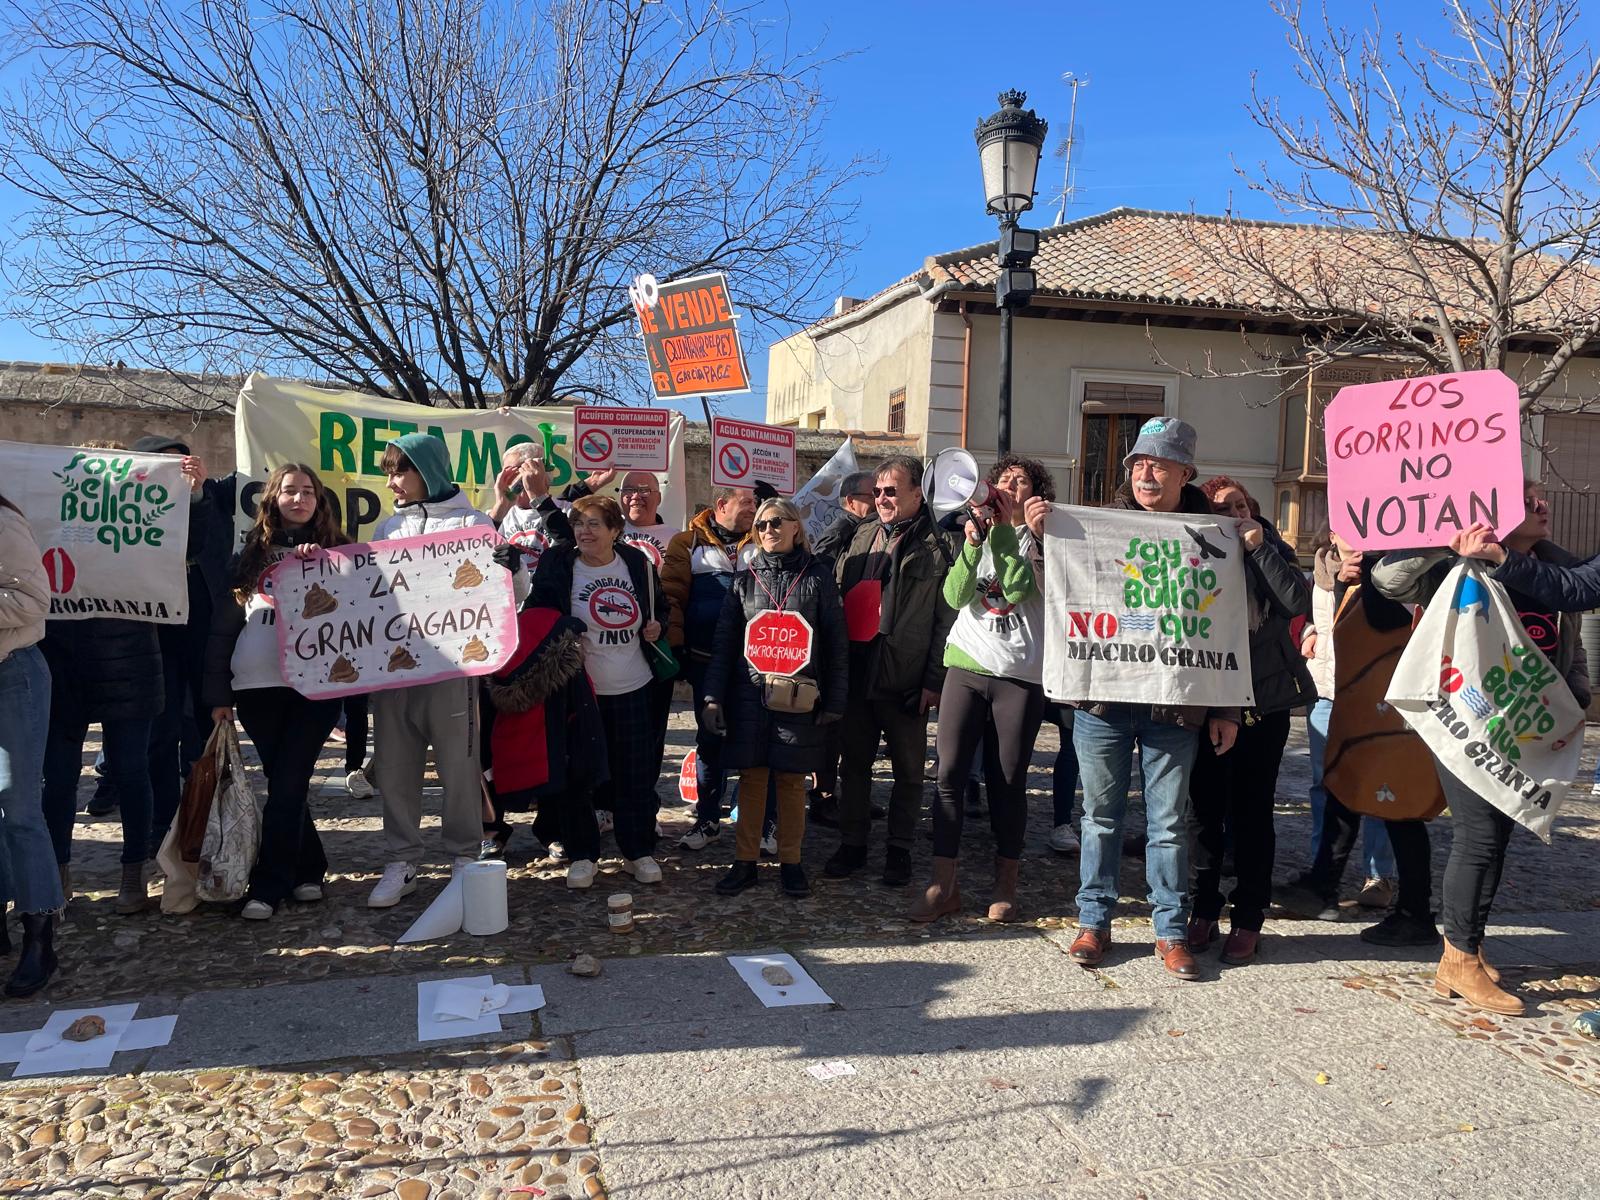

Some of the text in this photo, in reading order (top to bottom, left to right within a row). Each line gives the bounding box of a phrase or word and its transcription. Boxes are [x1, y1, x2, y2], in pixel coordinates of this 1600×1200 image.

[629, 273, 658, 311] NO
[660, 286, 729, 331] VENDE
[716, 332, 731, 357] REY
[1389, 378, 1464, 410] LOS
[581, 411, 663, 422] ACUÍFERO CONTAMINADO
[720, 425, 789, 444] AGUA CONTAMINADA
[1334, 412, 1506, 459] GORRINOS
[1400, 453, 1452, 483] NO
[1346, 487, 1499, 539] VOTAN
[97, 524, 164, 553] que
[42, 547, 76, 594] O
[302, 558, 341, 580] FIN
[354, 551, 377, 570] DE
[388, 547, 413, 565] LA
[369, 569, 410, 599] LA
[49, 598, 169, 618] ROGRANJA
[295, 603, 493, 661] GRAN CAGADA
[757, 626, 798, 642] STOP
[1068, 611, 1118, 639] NO
[1160, 613, 1212, 644] que
[748, 643, 808, 661] MACROGRANJAS
[1440, 655, 1463, 693] O
